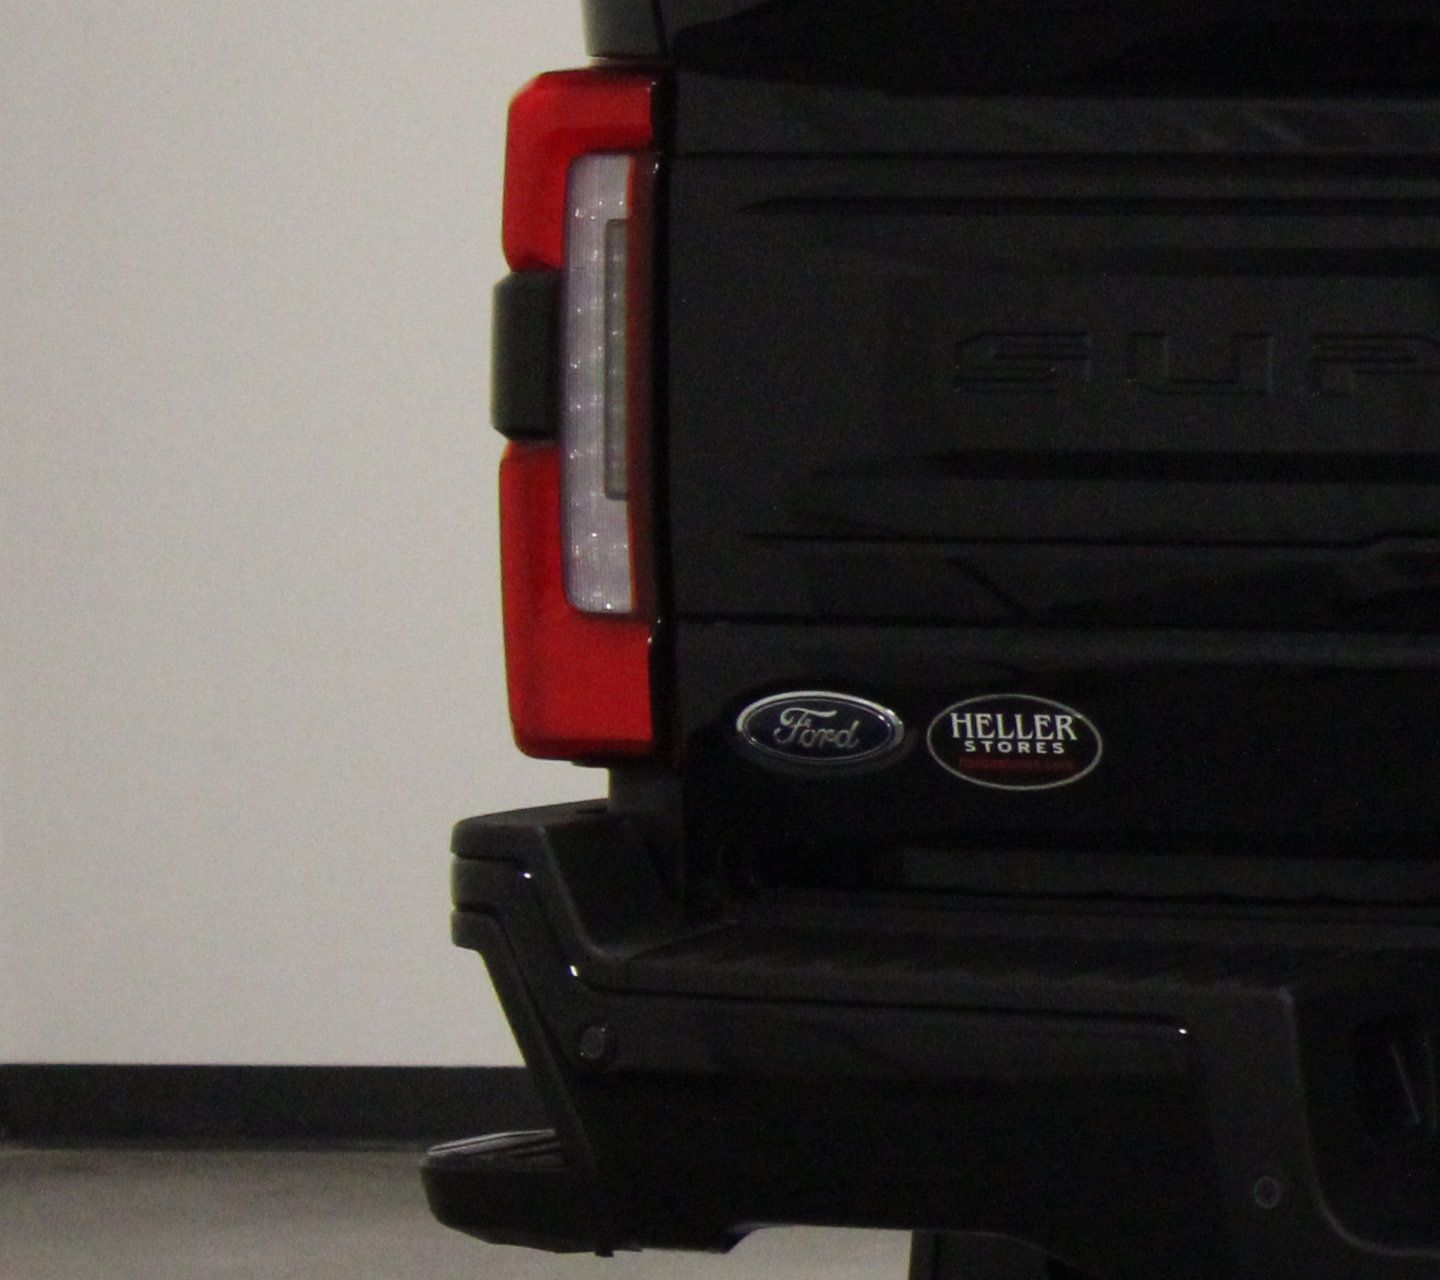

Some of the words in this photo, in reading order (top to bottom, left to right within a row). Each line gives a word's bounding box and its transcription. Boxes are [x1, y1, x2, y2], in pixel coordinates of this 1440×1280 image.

[773, 706, 860, 749] Ford
[950, 712, 1078, 741] HELLER
[964, 739, 1066, 755] STORES
